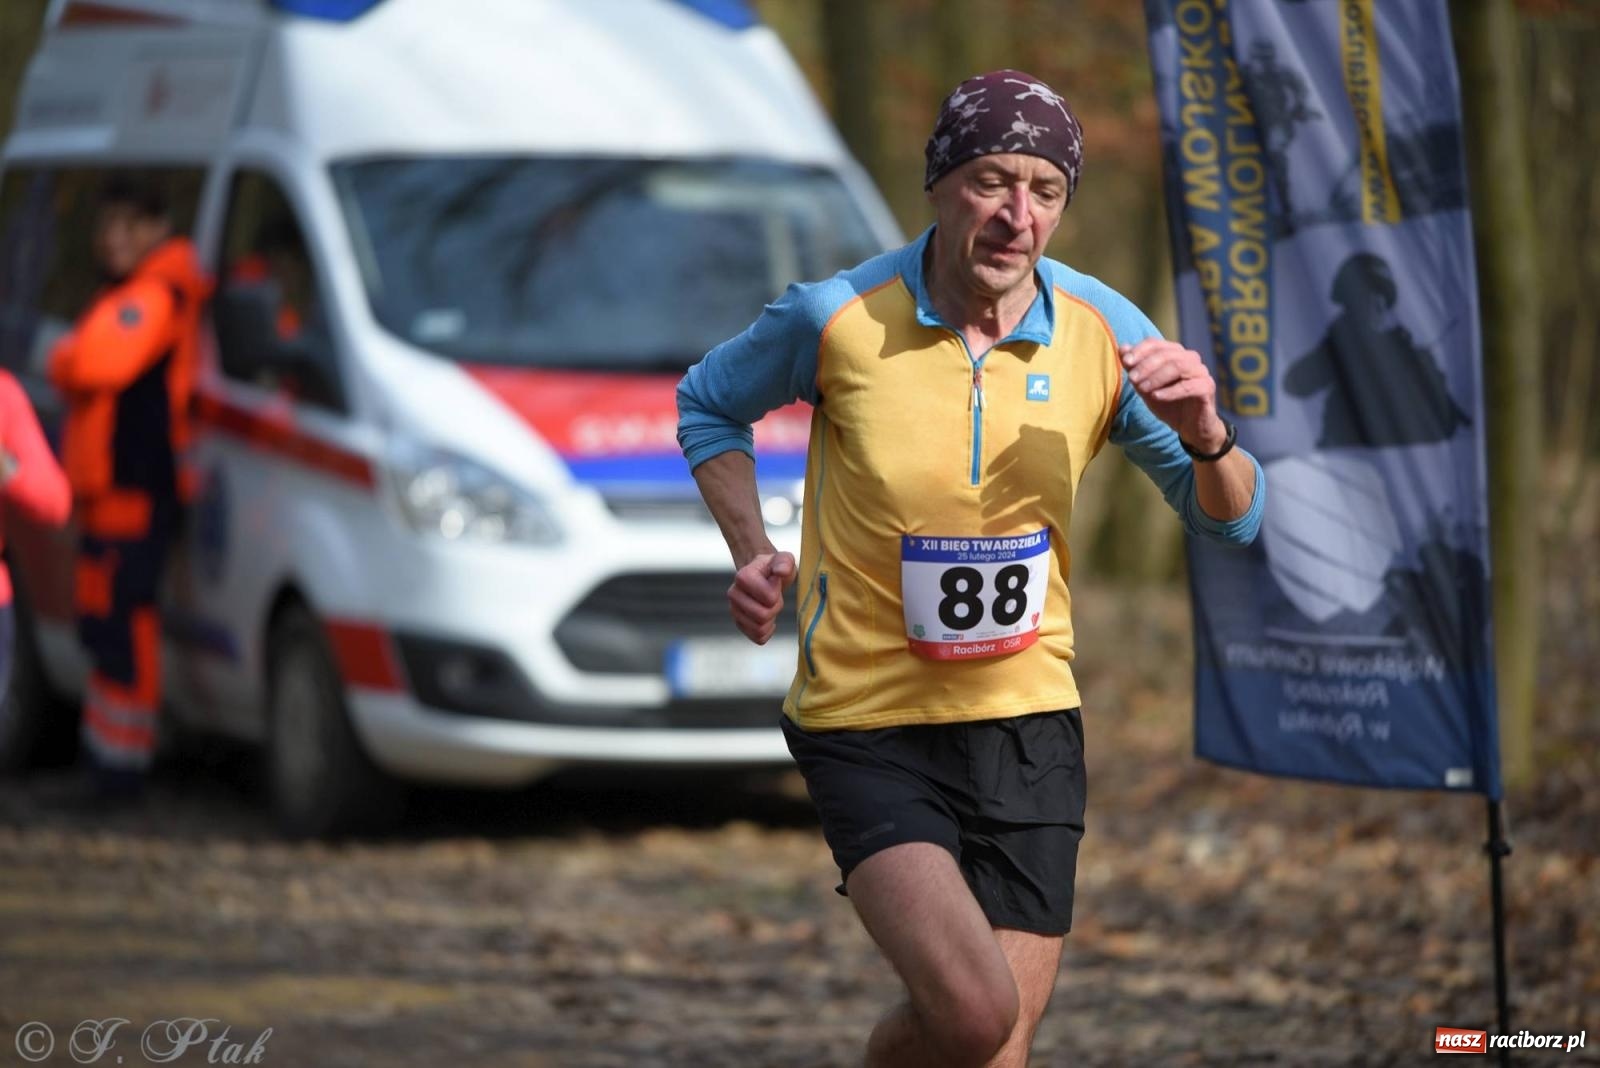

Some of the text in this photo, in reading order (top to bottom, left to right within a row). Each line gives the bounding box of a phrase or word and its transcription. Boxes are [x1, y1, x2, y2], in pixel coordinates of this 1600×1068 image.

[922, 533, 1041, 551] XII BIEG TWARDZIELA
[957, 551, 1016, 562] 25 lutego 2024
[938, 564, 1029, 630] 88
[953, 643, 996, 655] Racibórz
